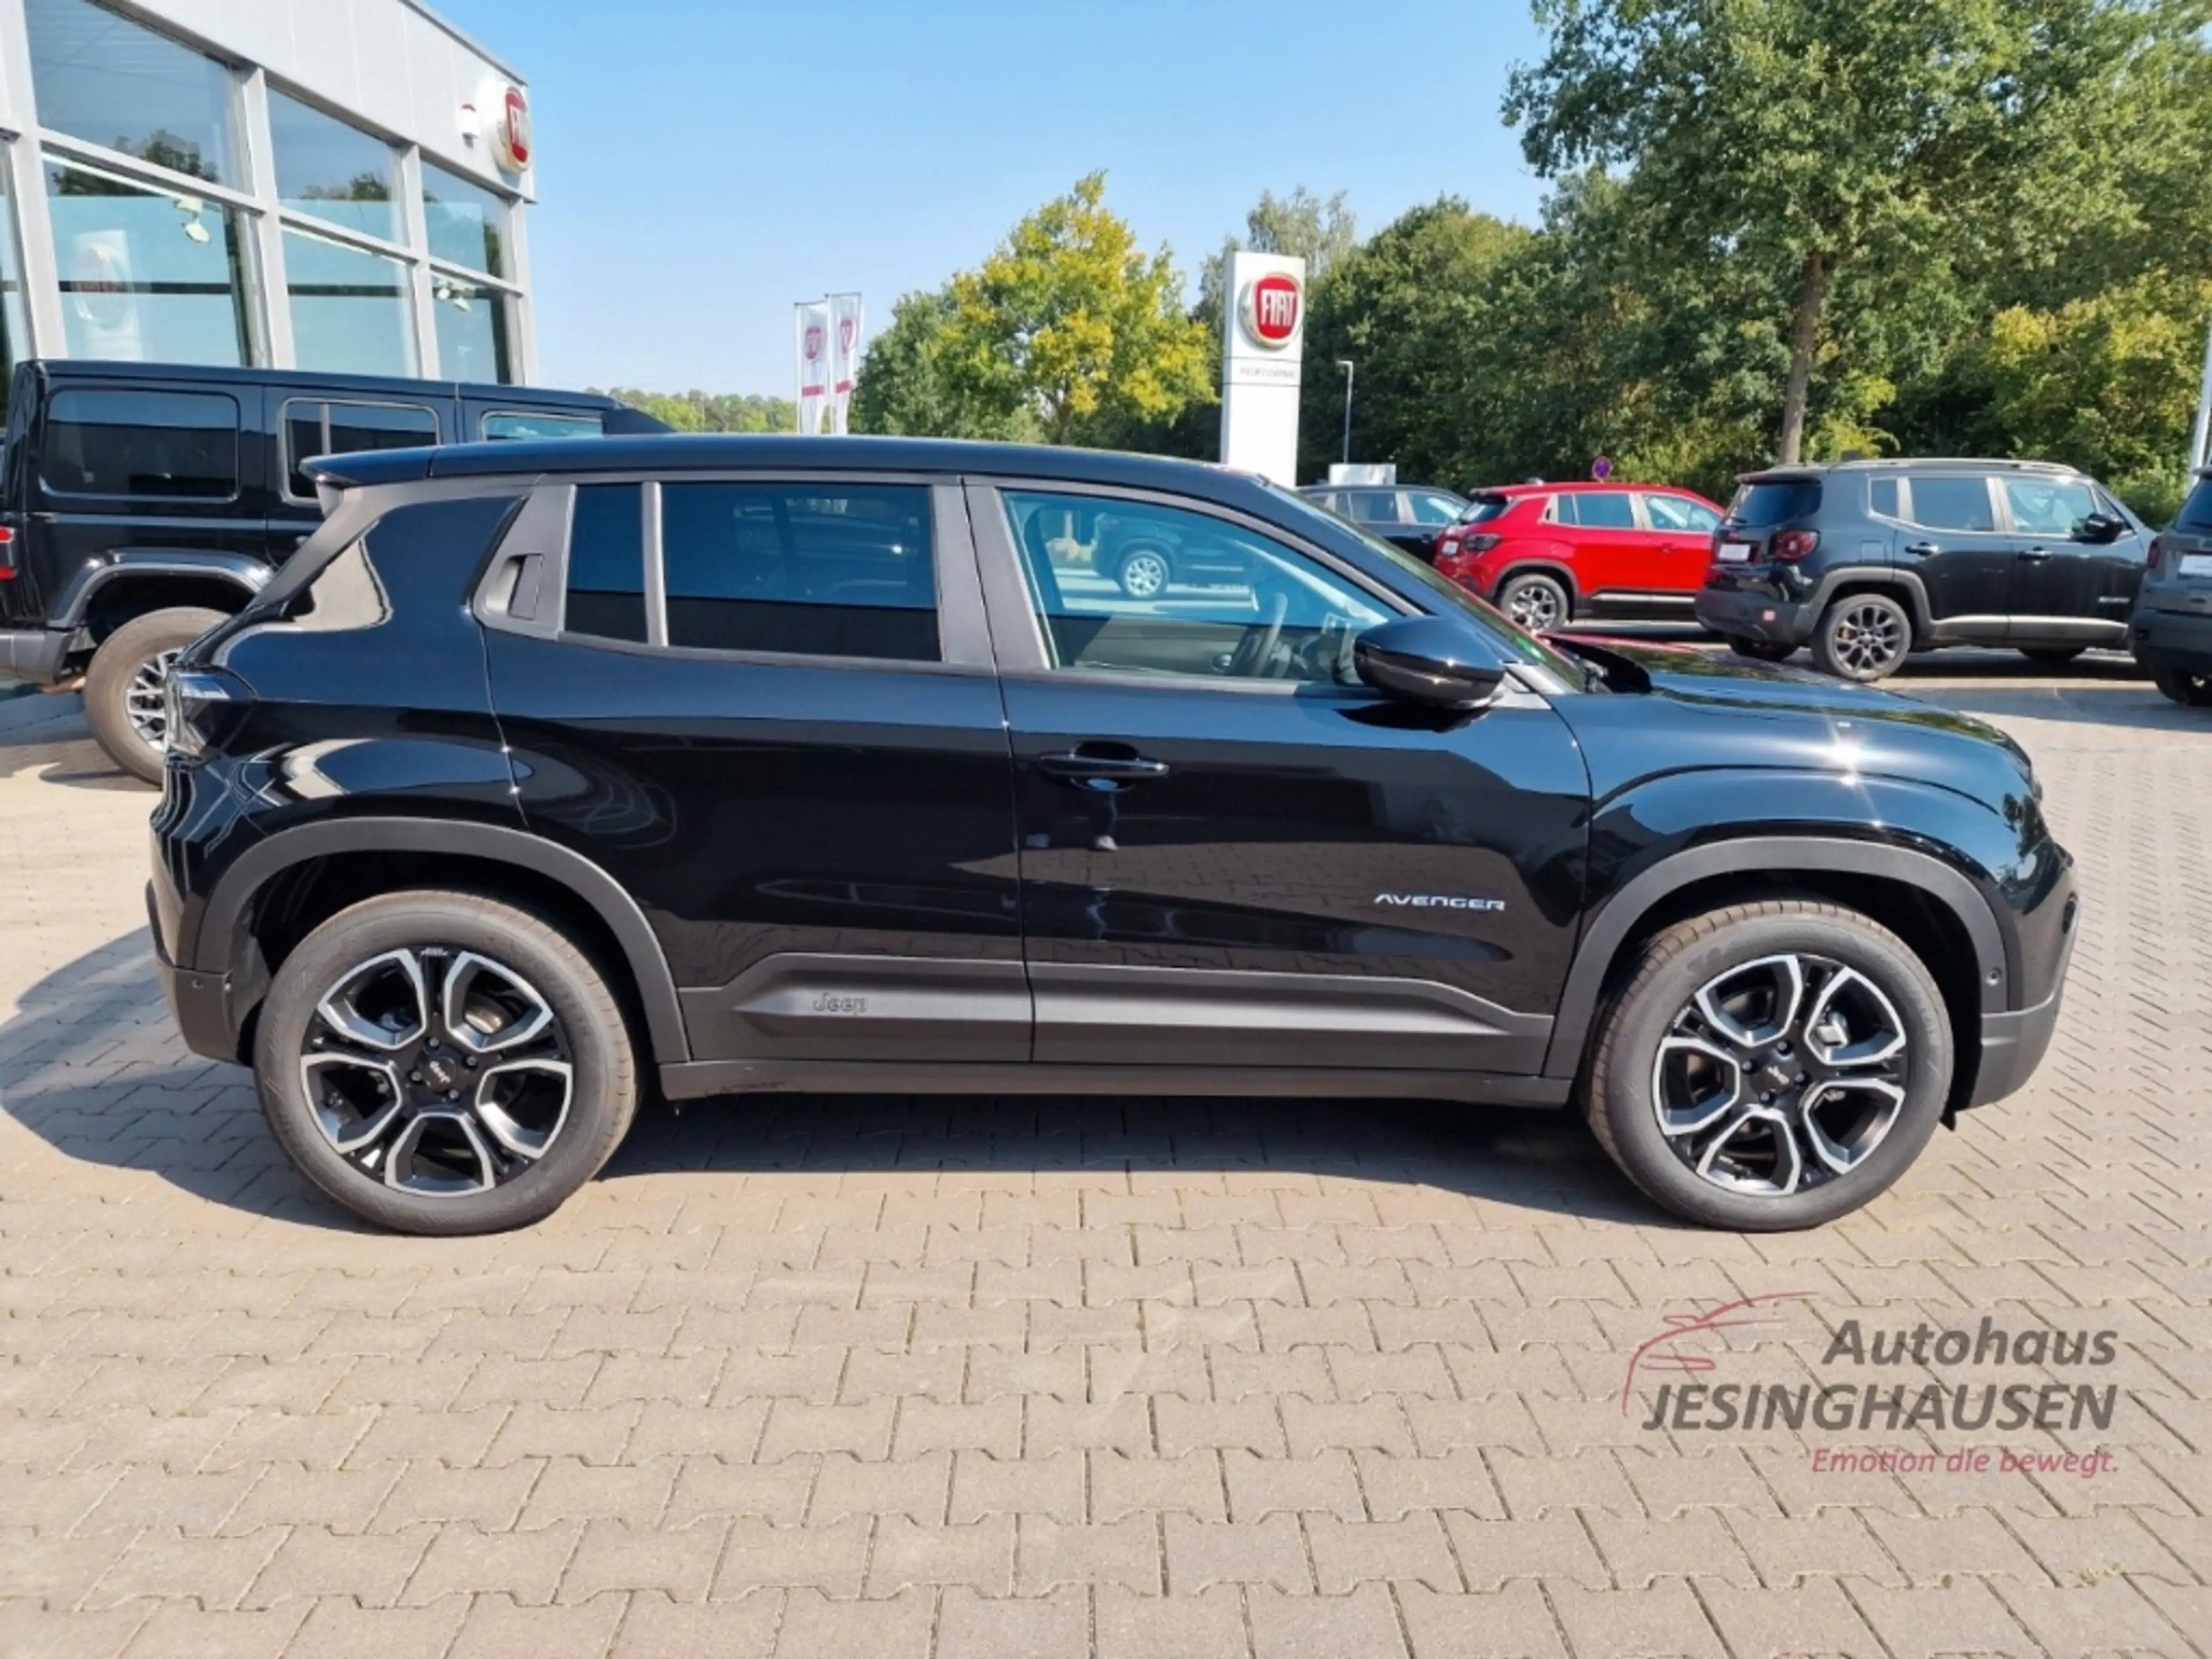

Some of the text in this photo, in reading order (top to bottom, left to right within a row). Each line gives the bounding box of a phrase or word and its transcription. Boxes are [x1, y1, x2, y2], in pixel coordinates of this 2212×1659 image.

[1261, 289, 1295, 327] FIAT
[1374, 893, 1505, 911] AVENGER
[812, 991, 866, 1017] Jeep
